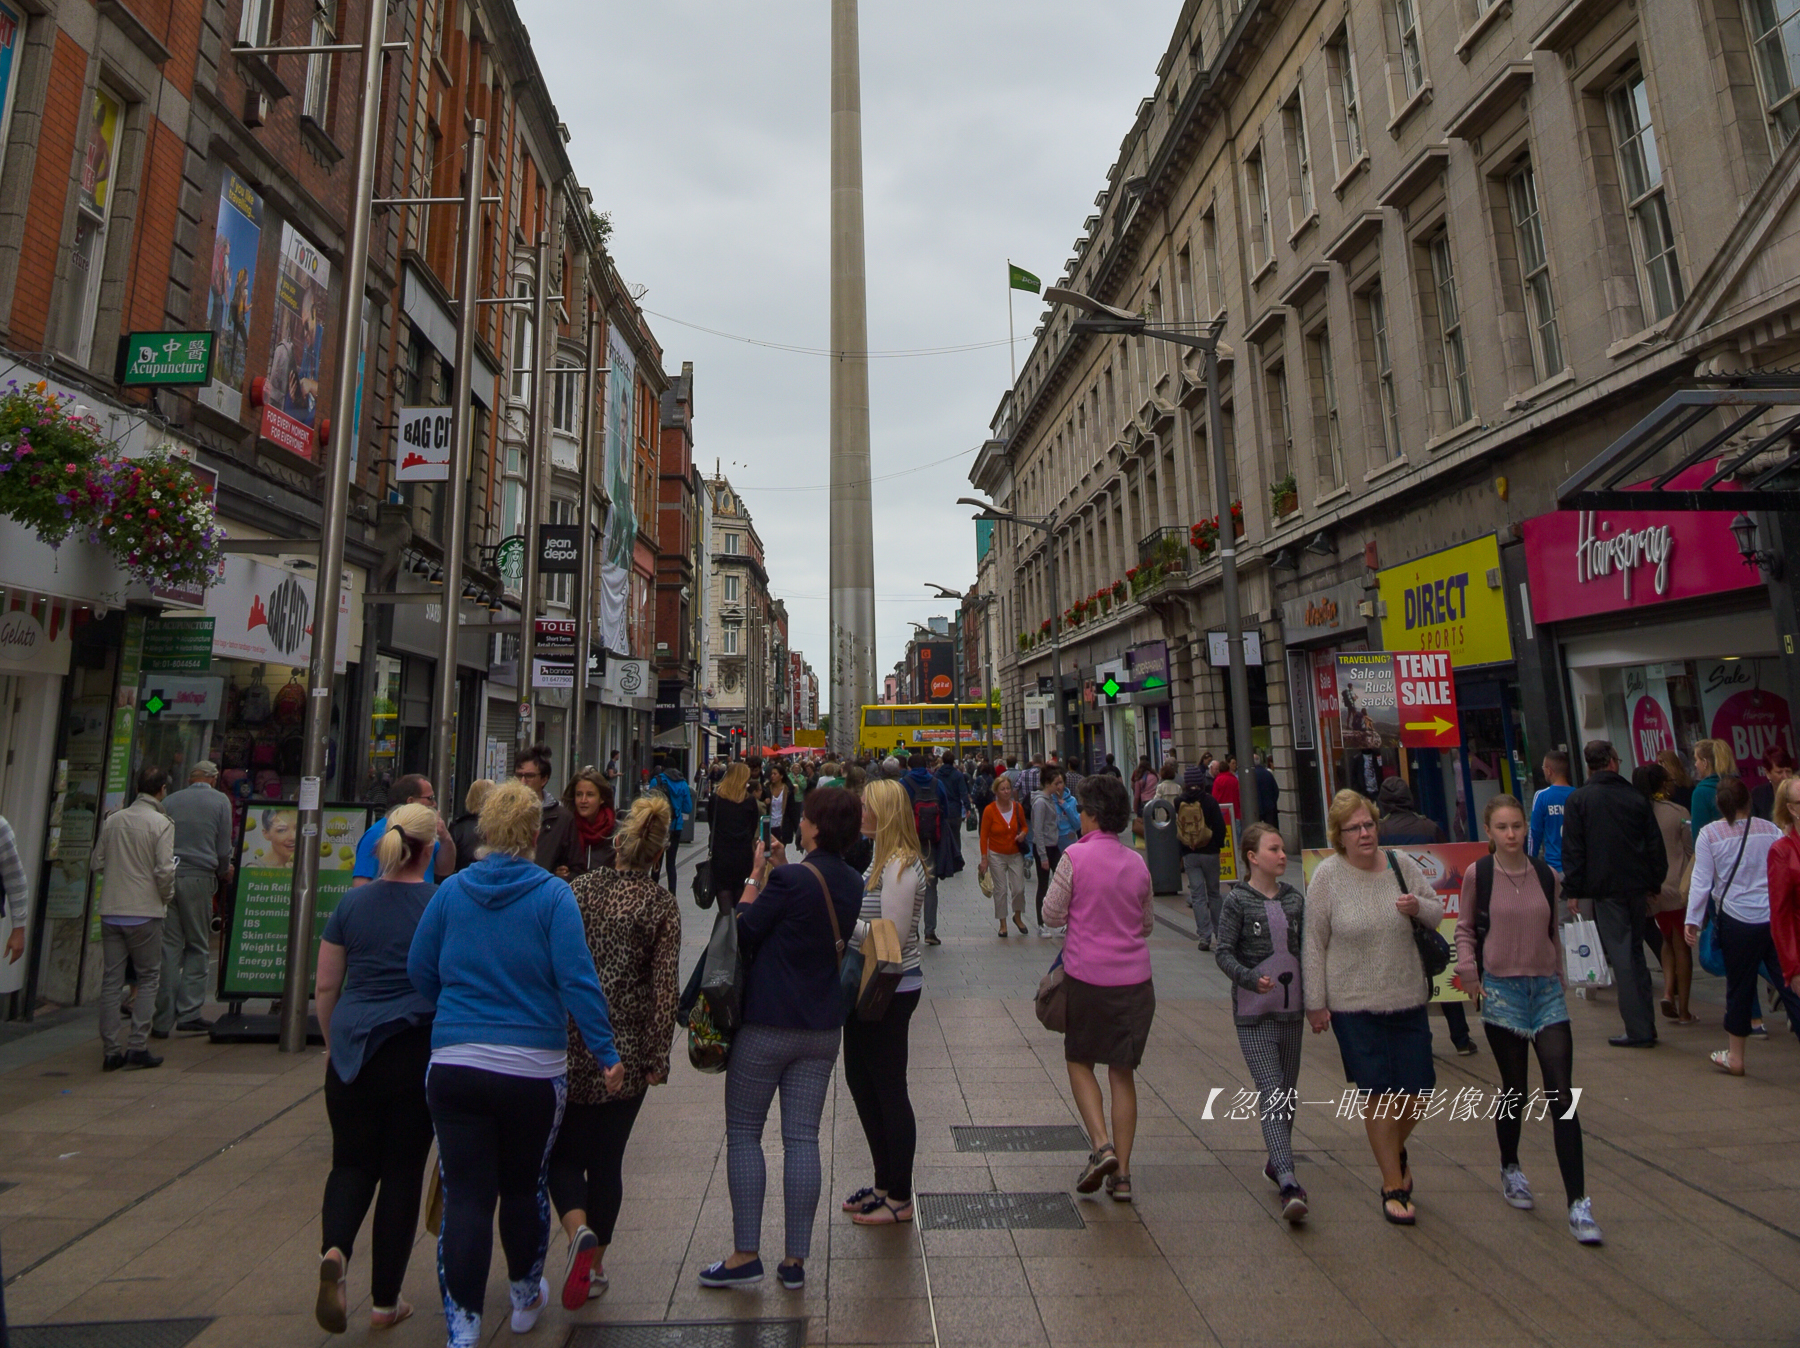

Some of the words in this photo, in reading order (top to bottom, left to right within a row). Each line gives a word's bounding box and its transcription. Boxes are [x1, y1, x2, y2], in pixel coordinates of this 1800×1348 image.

[295, 238, 318, 274] TOTTO
[138, 346, 158, 363] Dr
[162, 338, 207, 362] 中醫
[128, 361, 205, 378] Acupuncture
[404, 416, 431, 449] BAG
[545, 536, 571, 549] jean
[544, 549, 577, 561] depot
[1576, 511, 1673, 601] Hairspray
[1404, 572, 1469, 630] DIRECT
[267, 579, 289, 654] BAG
[163, 621, 213, 630] ACUPUNCTURE
[541, 622, 556, 631] TO
[1, 619, 36, 647] Gelato
[1421, 625, 1464, 651] SPORTS
[1339, 655, 1391, 664] TRAVELLING?
[1396, 654, 1448, 678] TENT
[620, 662, 641, 691] 3
[1350, 668, 1375, 680] Sale
[1378, 670, 1391, 679] on
[1704, 664, 1751, 693] Sale
[1365, 681, 1394, 693] Ruck
[1401, 681, 1451, 705] SALE
[1361, 695, 1394, 706] sacks
[1640, 729, 1659, 762] BUY
[1731, 725, 1777, 760] BUY
[1781, 724, 1795, 759] 1
[325, 820, 354, 831] whole
[248, 882, 269, 891] Pain
[271, 883, 291, 891] Reli
[246, 894, 291, 905] Infertility
[244, 908, 289, 917] Insomnia
[243, 919, 260, 927] IBS
[242, 931, 263, 940] Skin
[241, 942, 274, 953] Weight
[238, 956, 273, 967] Energy
[236, 969, 276, 980] improve
